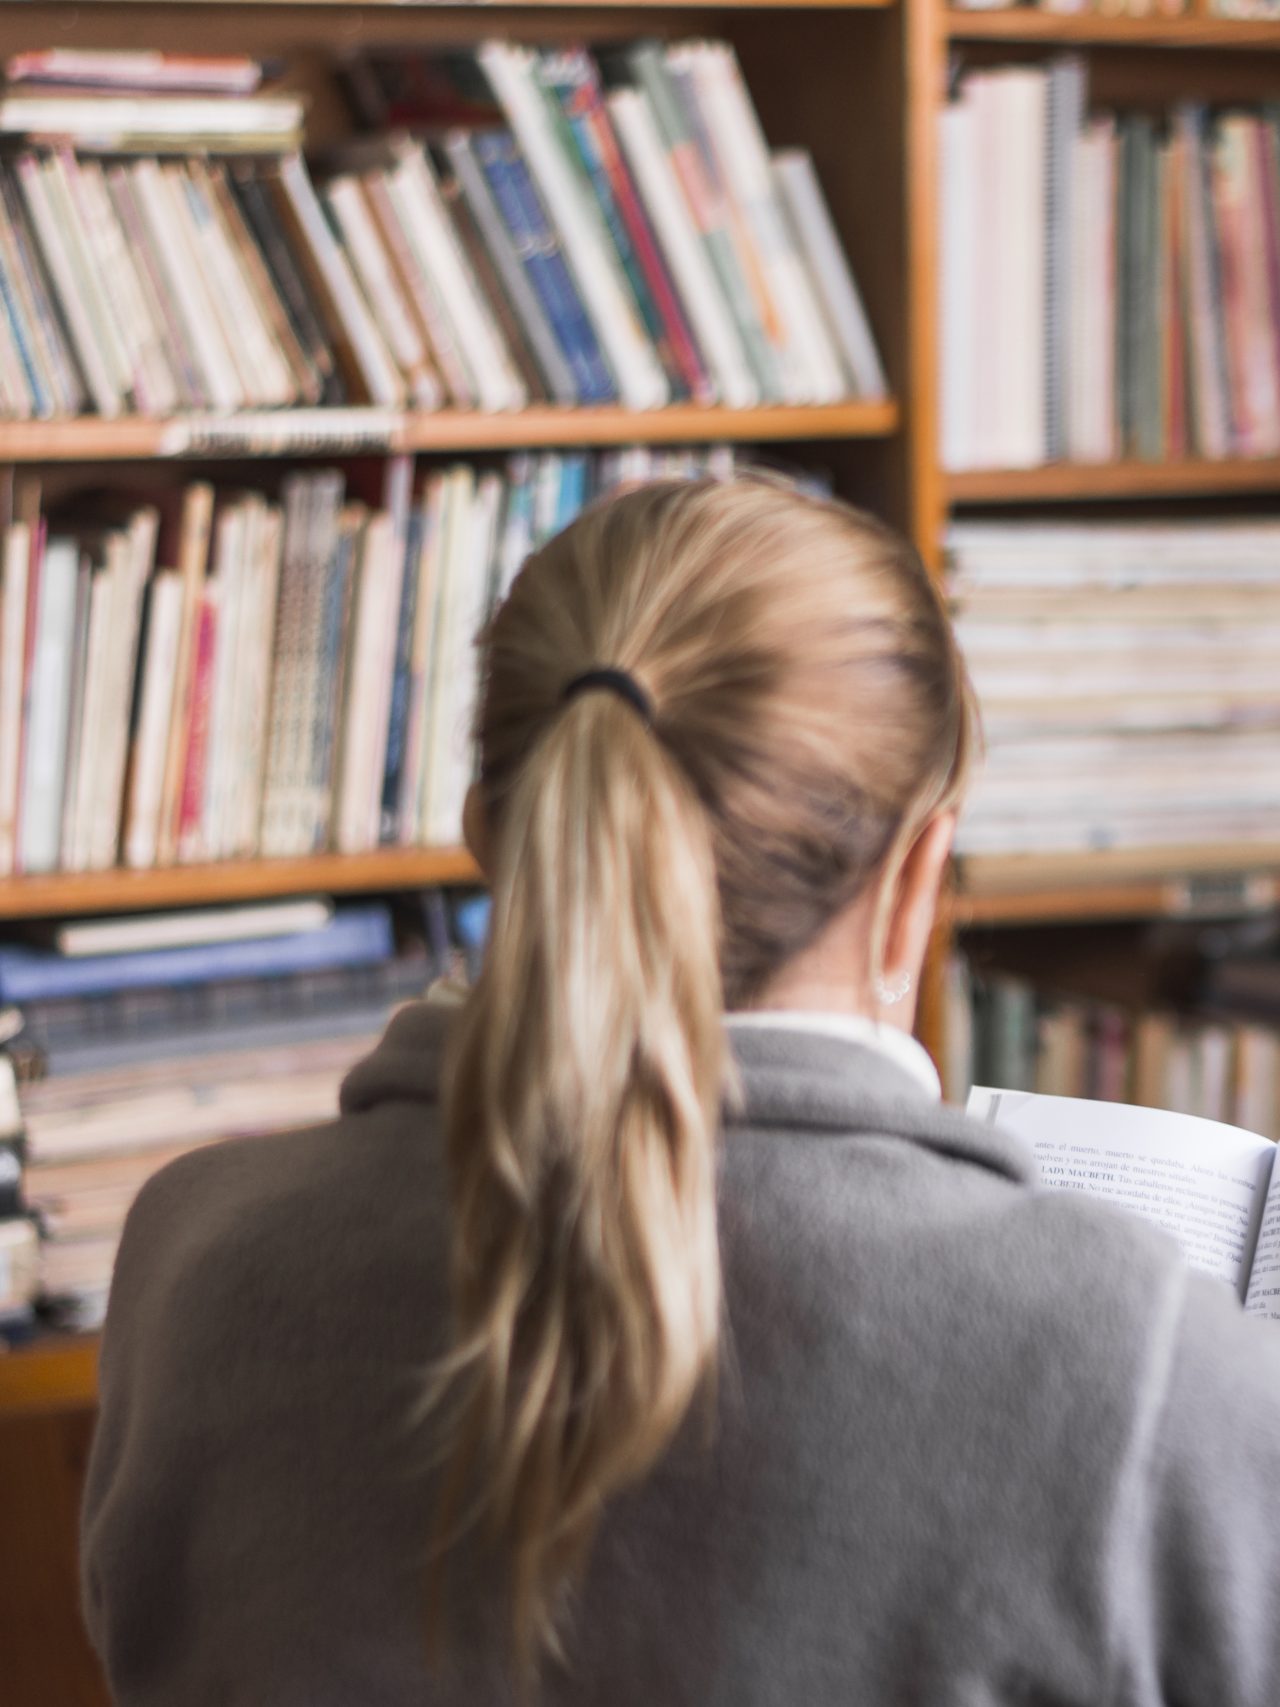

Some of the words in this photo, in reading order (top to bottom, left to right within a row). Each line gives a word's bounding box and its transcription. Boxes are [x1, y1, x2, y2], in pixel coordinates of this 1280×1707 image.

[1058, 1143, 1067, 1151] el
[1120, 1163, 1130, 1171] de
[1041, 1165, 1065, 1175] LADY
[1068, 1168, 1115, 1182] MACBETH.
[1134, 1179, 1173, 1190] caballeros
[1040, 1178, 1086, 1190] MACBETH.
[1089, 1182, 1101, 1191] No
[1152, 1191, 1161, 1201] de
